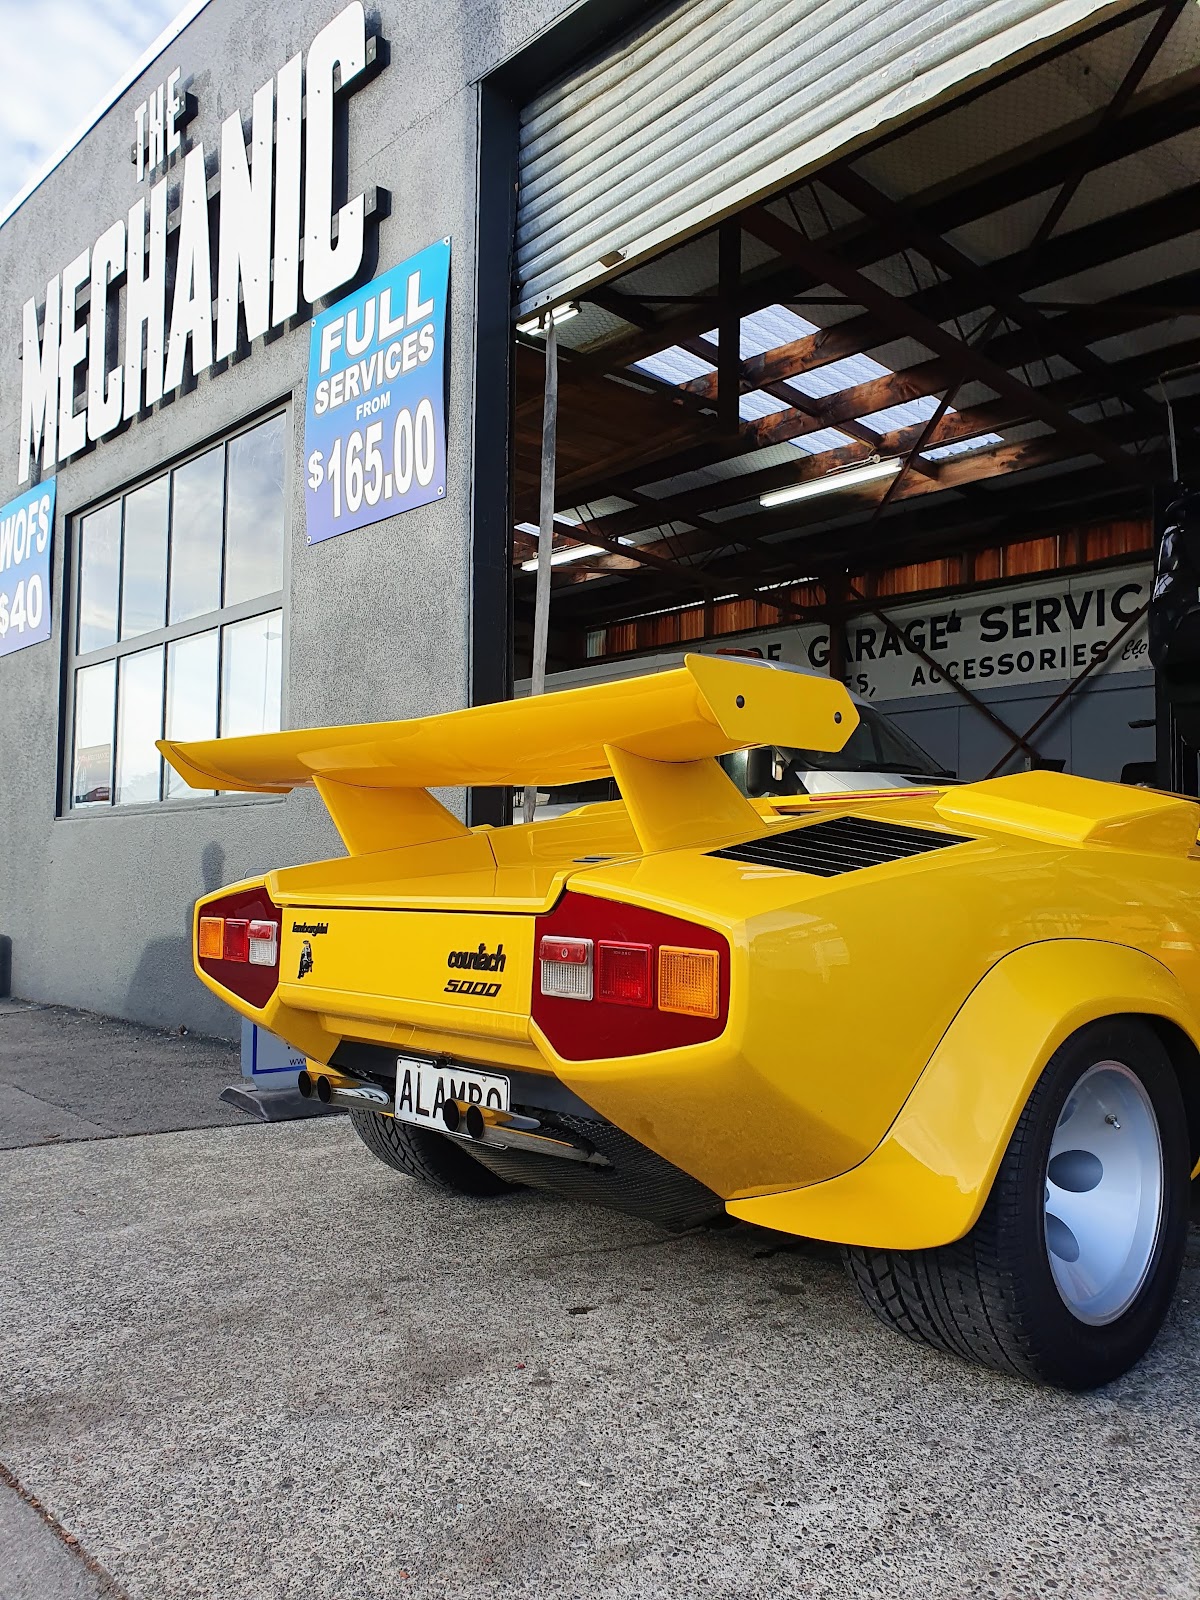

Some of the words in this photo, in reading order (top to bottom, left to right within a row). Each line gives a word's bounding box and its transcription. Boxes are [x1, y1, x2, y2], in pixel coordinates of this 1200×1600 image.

[135, 66, 180, 183] THE
[18, 0, 365, 484] MECHANIC
[320, 271, 434, 374] FULL
[315, 323, 435, 416] SERVICES
[356, 391, 391, 421] FROM
[307, 398, 435, 518] $165.00
[0, 494, 50, 573] WOFS
[0, 574, 43, 638] $40
[980, 583, 1153, 643] SERVIC
[911, 640, 1109, 687] ACCESSORIES
[443, 979, 502, 997] 5000
[447, 943, 507, 972] countach
